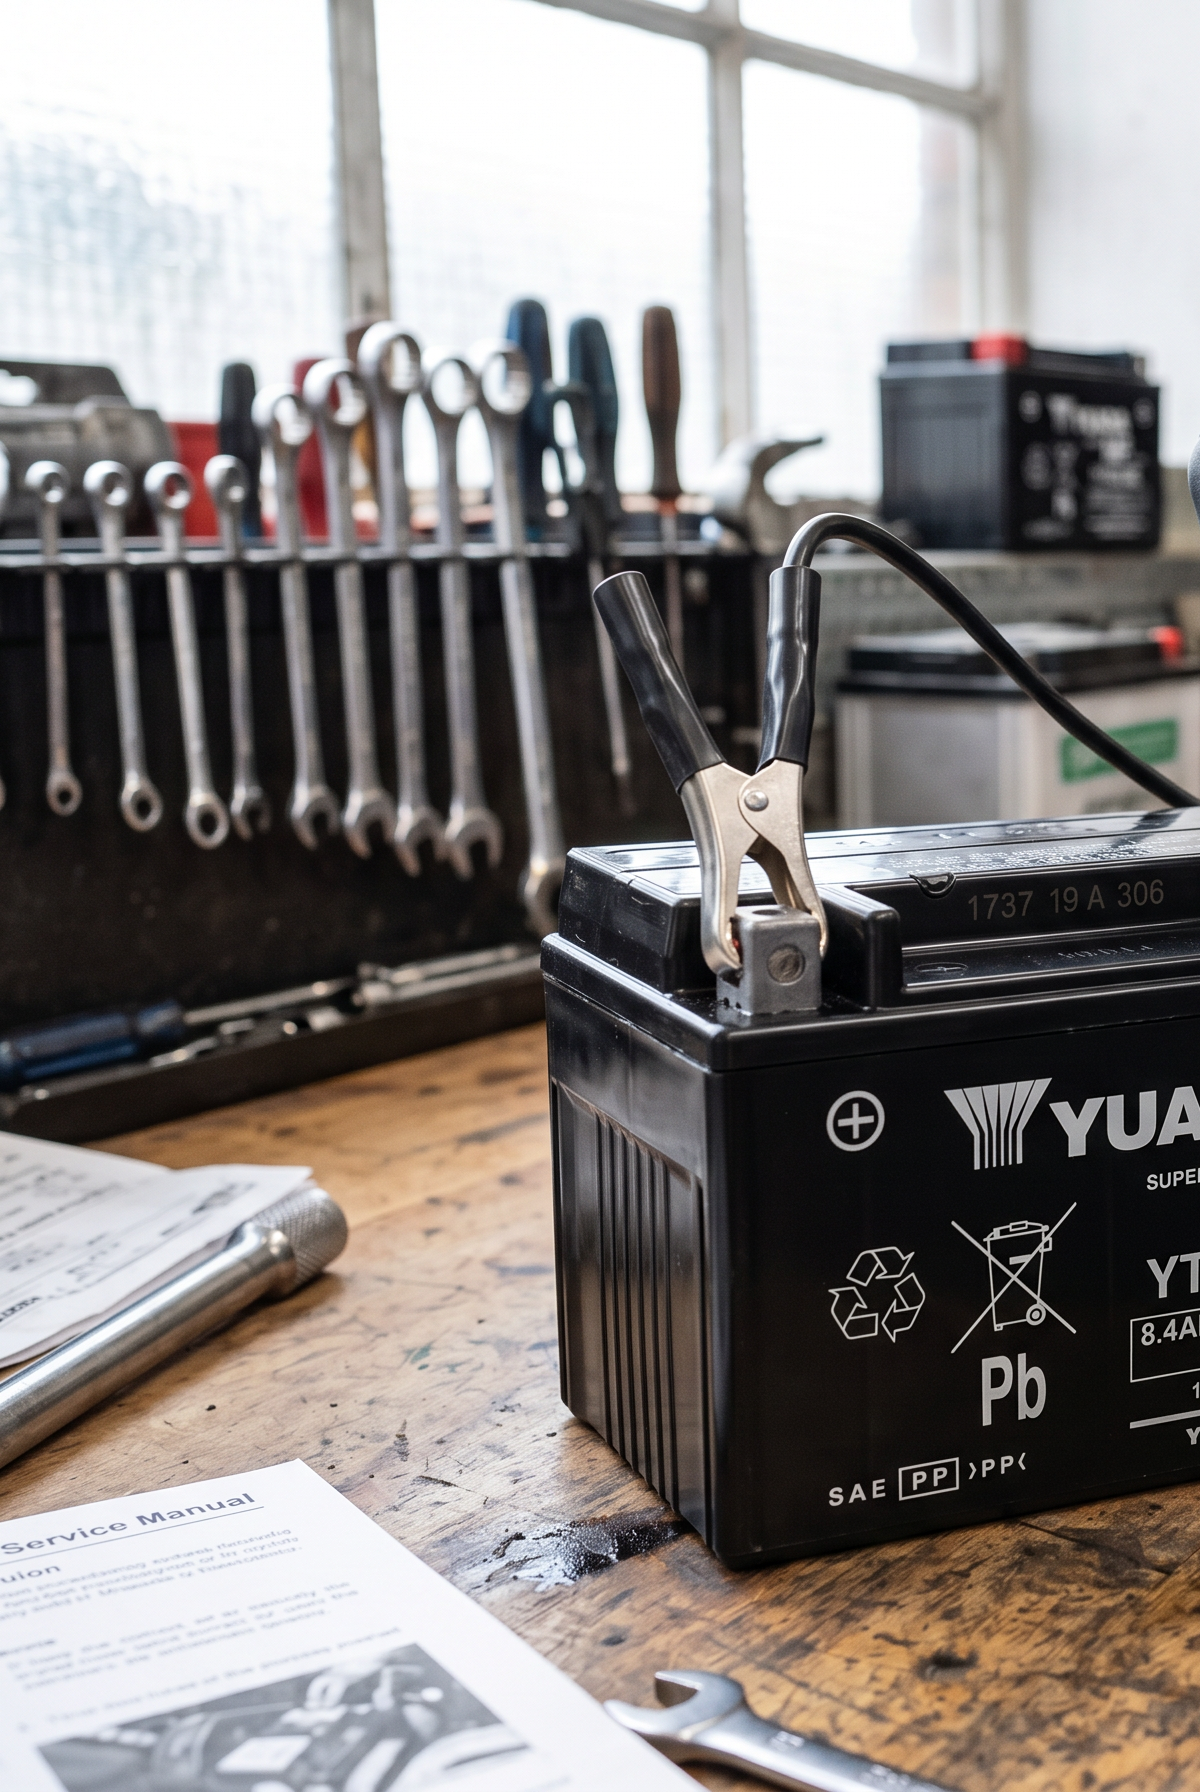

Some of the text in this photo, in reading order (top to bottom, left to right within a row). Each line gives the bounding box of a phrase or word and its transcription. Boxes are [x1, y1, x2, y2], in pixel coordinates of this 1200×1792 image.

[967, 878, 1164, 921] 1737 19 A 306
[981, 1352, 1047, 1427] Pb
[828, 1478, 886, 1507] SAE
[912, 1467, 948, 1491] PP
[0, 1492, 257, 1555] Service Manual
